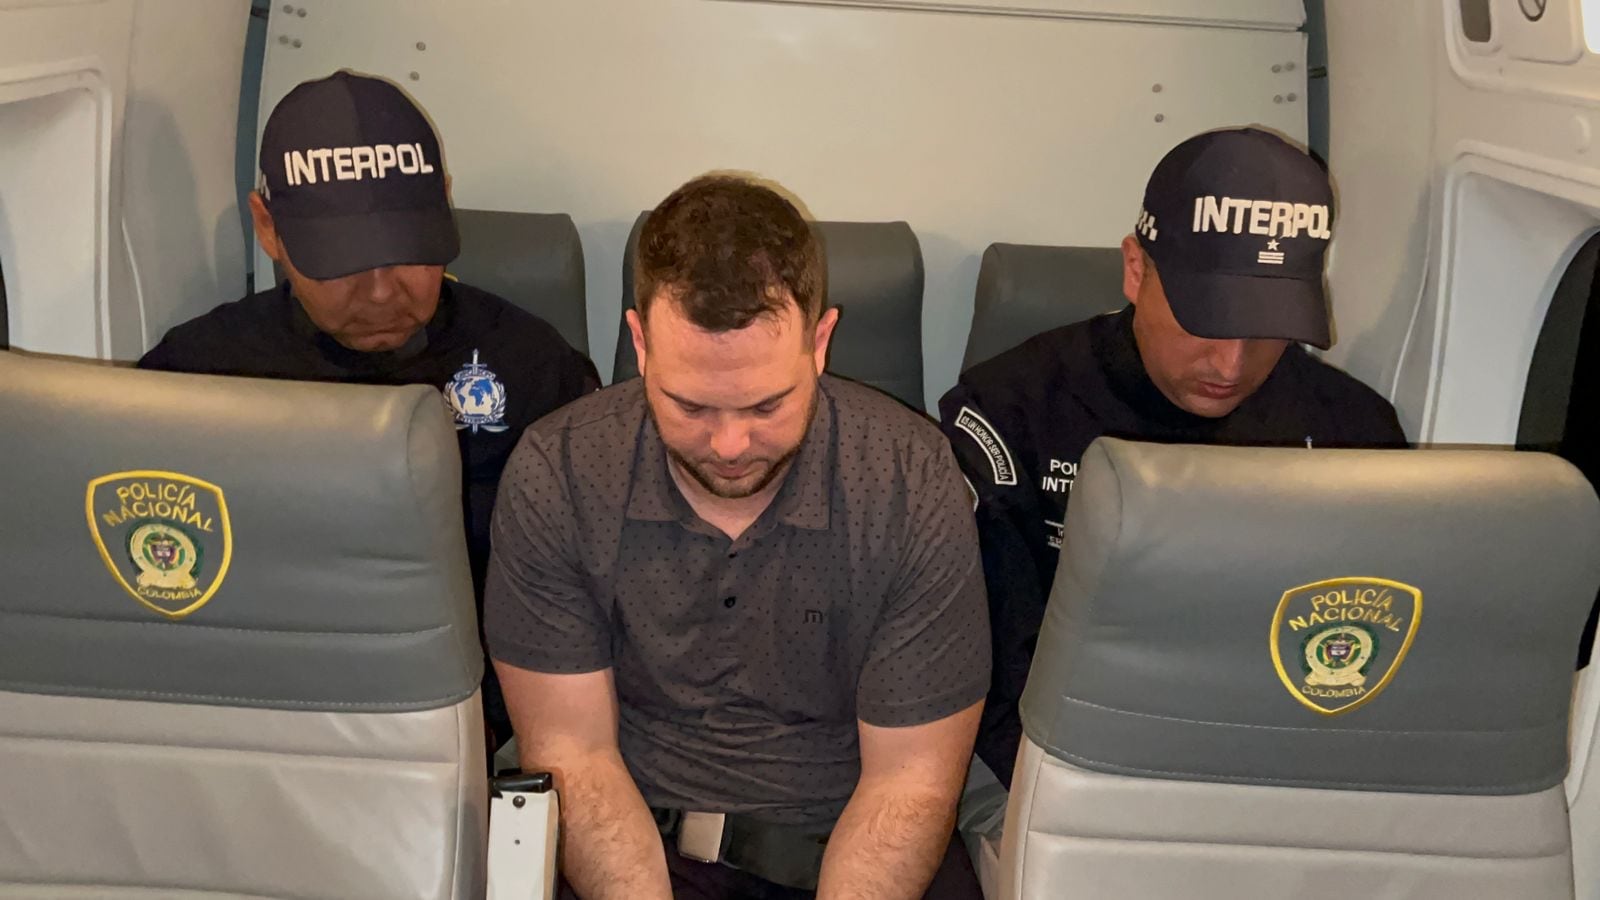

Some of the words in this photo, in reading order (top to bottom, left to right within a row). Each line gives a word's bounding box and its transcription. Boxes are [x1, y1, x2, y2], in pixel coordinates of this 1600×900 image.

[284, 143, 433, 186] INTERPOL
[1193, 196, 1330, 240] INTERPOL
[967, 419, 978, 430] UN
[974, 425, 994, 447] HONOR
[989, 444, 1001, 457] SER
[102, 502, 213, 533] NACIONAL
[137, 586, 202, 600] COLOMBIA
[1288, 607, 1404, 632] NACIONAL
[1302, 685, 1366, 698] COLOMBIA
